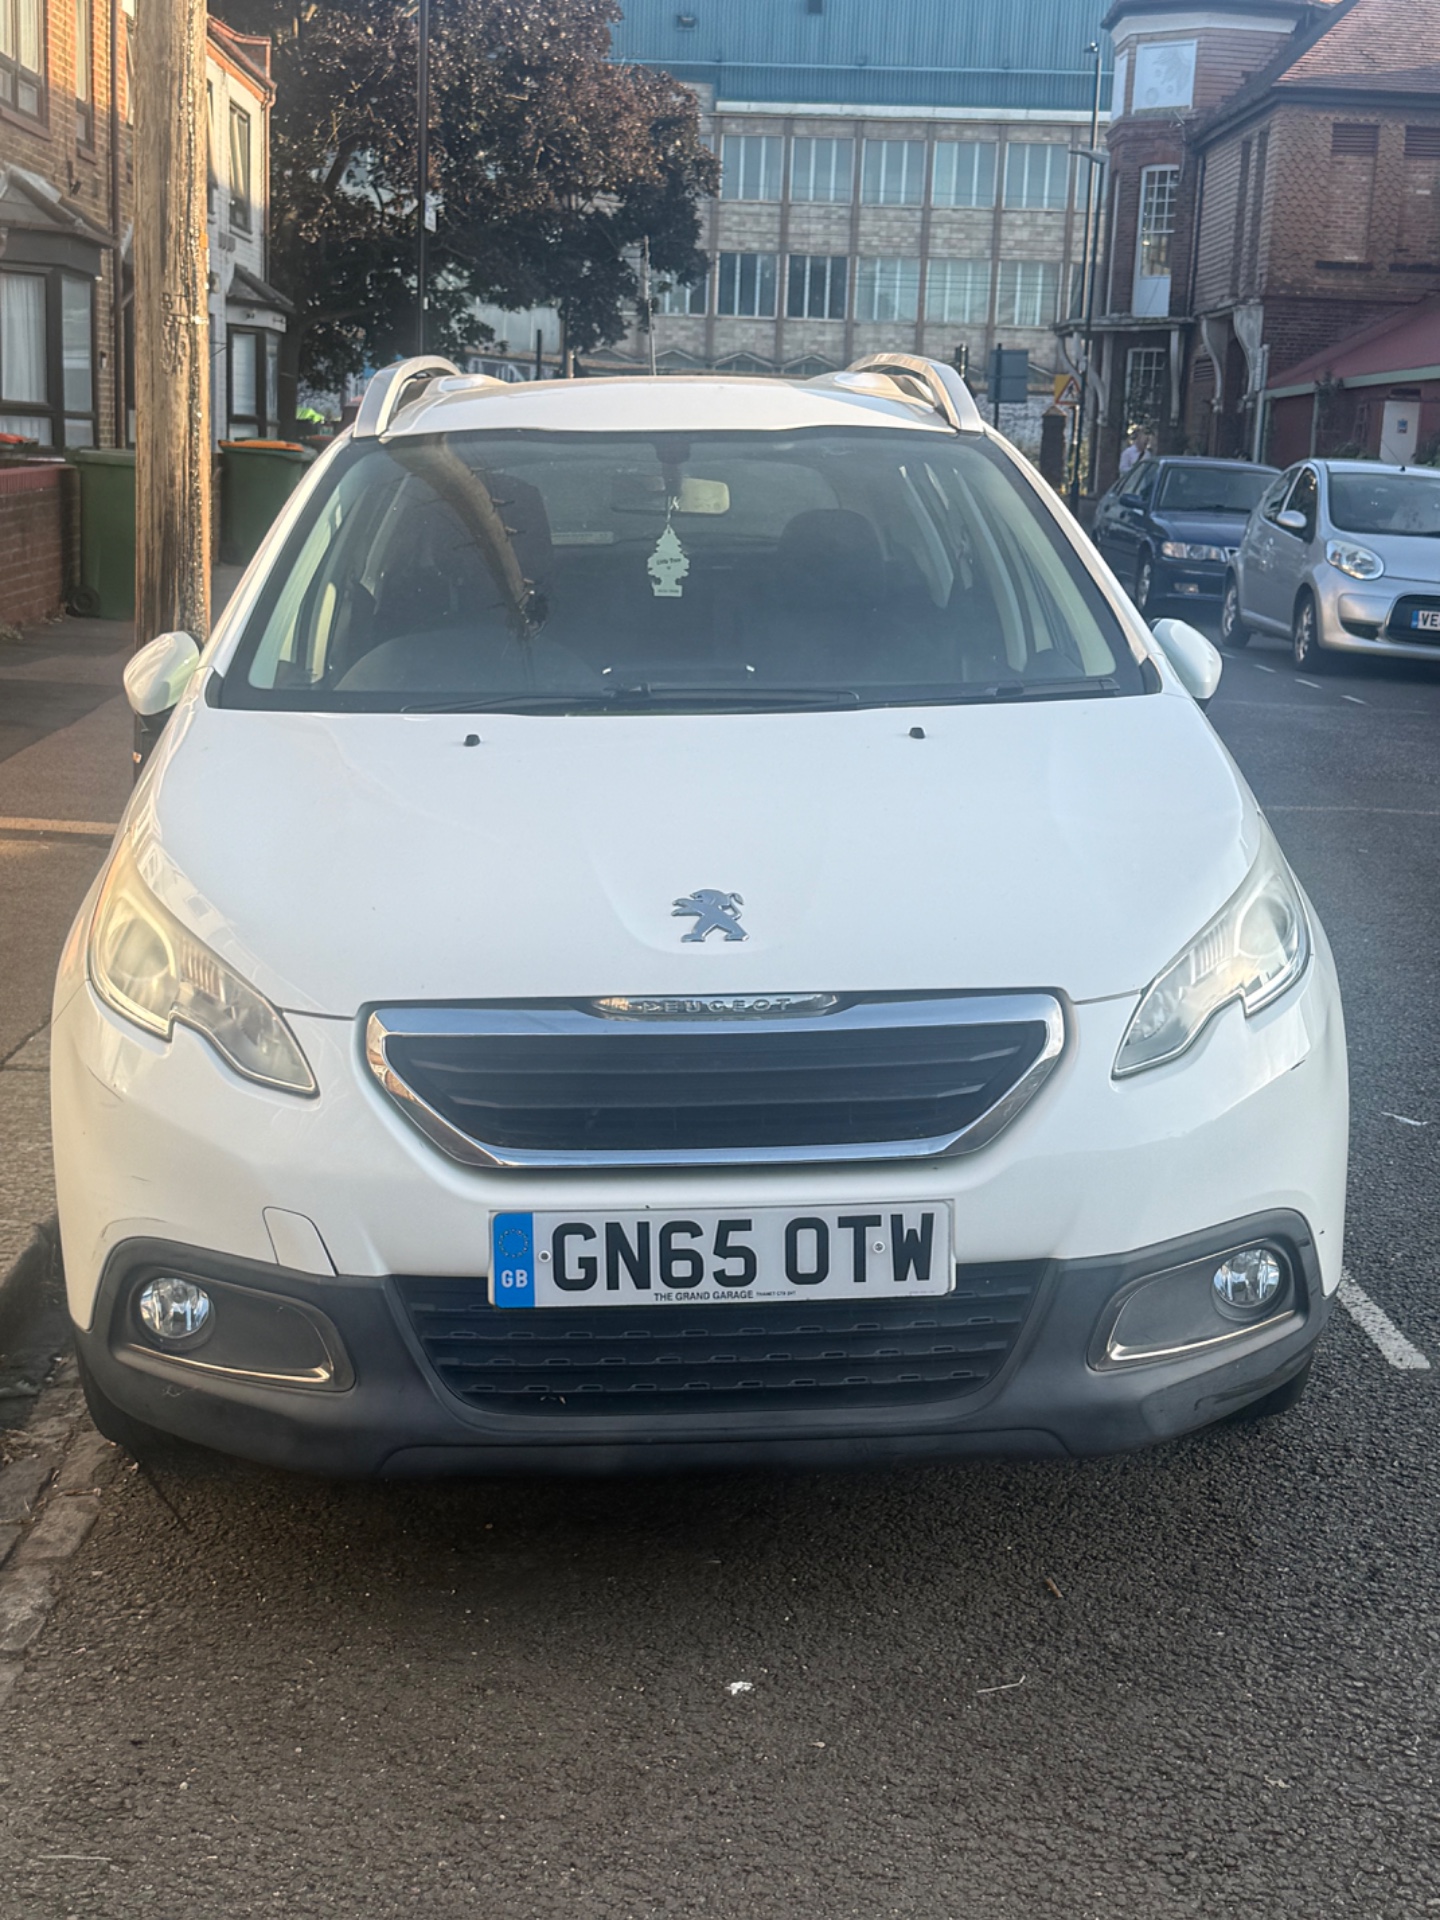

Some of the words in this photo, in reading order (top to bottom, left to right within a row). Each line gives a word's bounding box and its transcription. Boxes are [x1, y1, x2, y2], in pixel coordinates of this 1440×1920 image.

[642, 998, 791, 1013] PEUGEOT
[552, 1219, 757, 1291] GN65
[785, 1213, 935, 1286] OTW
[501, 1269, 528, 1288] GB
[654, 1292, 673, 1302] THE
[675, 1291, 710, 1301] GRAND
[712, 1290, 754, 1300] GARAGE
